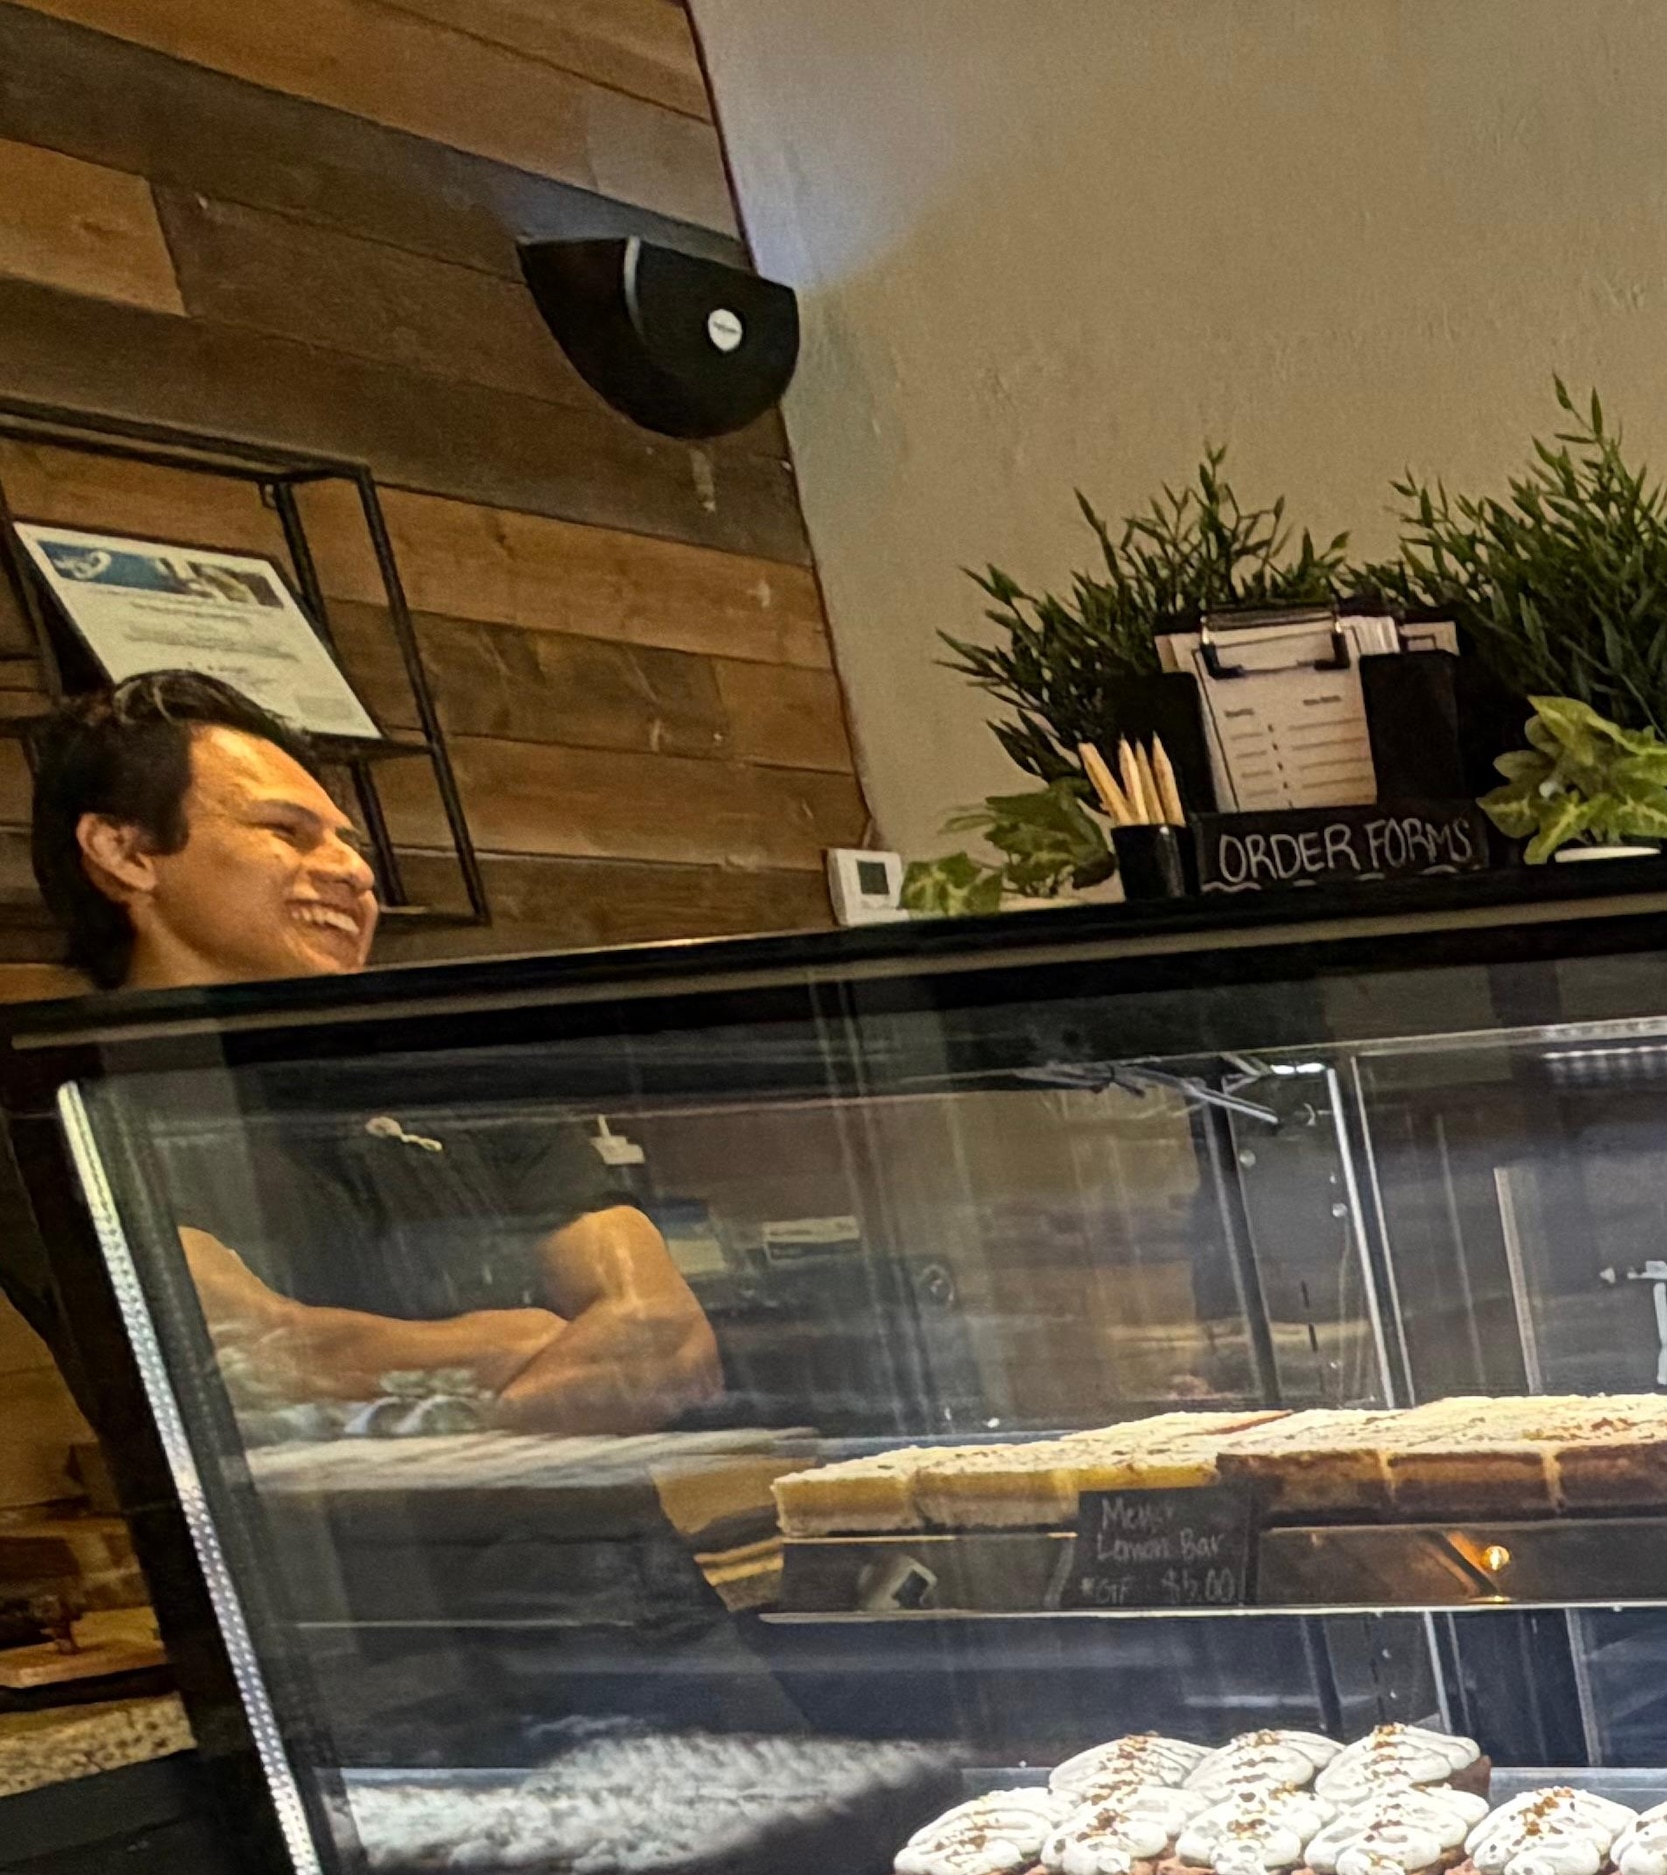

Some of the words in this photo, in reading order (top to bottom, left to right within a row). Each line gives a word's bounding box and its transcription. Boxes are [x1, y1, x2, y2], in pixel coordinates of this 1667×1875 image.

[1218, 823, 1361, 884] ORDER
[1364, 817, 1472, 870] FORMS
[1096, 1532, 1172, 1562] Lemon
[1180, 1526, 1226, 1561] Bar
